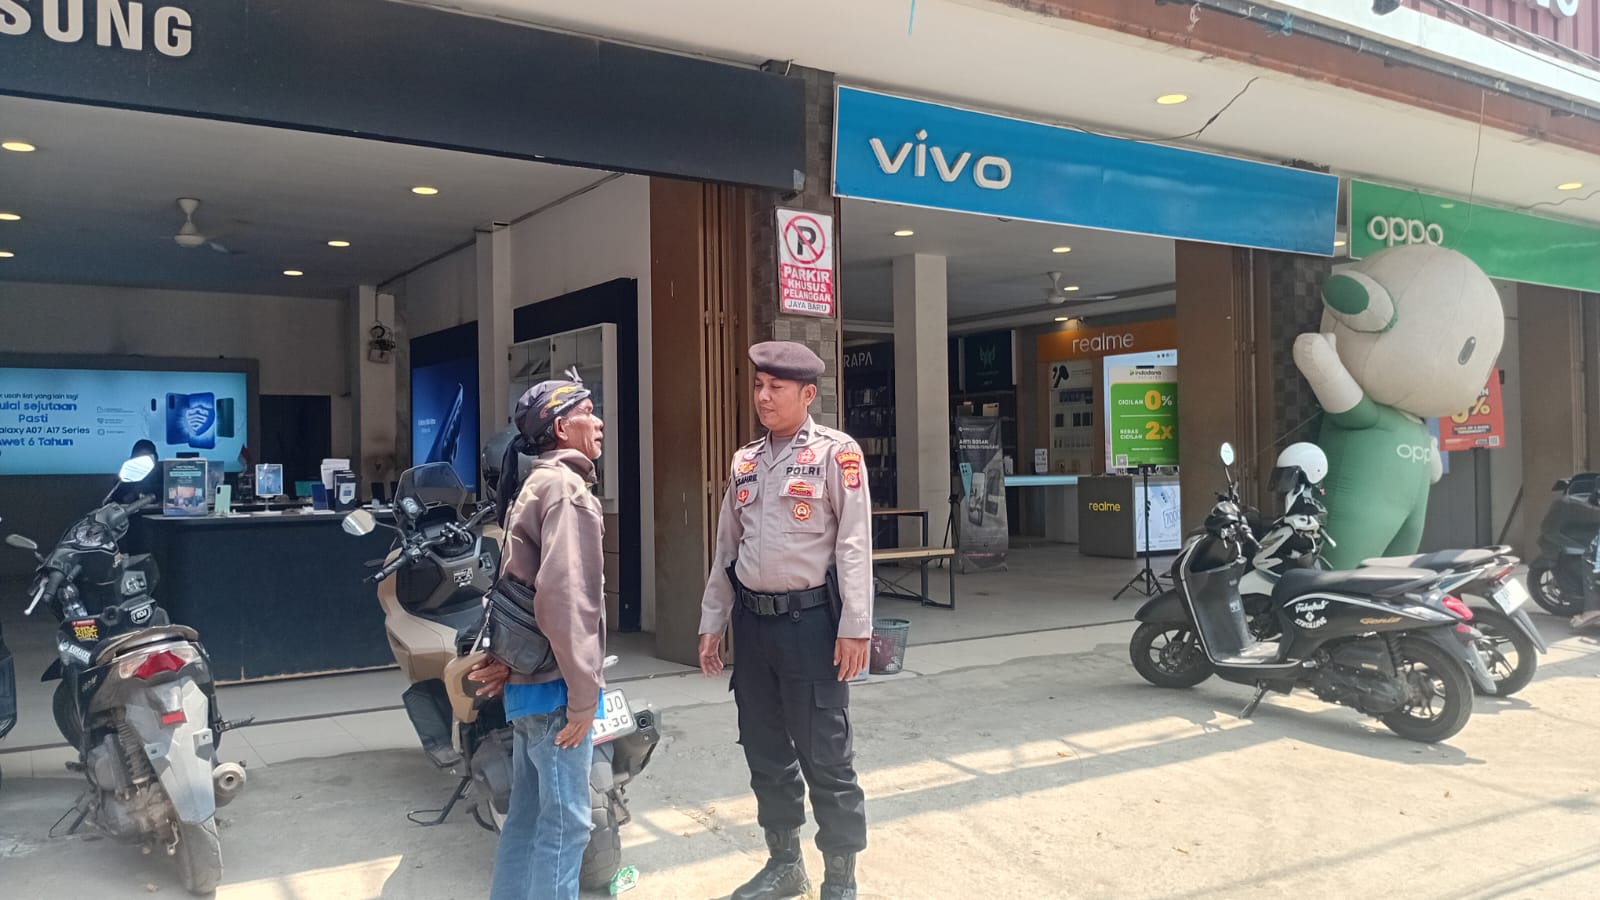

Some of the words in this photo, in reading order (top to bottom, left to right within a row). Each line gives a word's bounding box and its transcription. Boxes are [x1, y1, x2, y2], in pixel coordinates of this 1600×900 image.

[869, 129, 1012, 190] vivo
[1367, 215, 1443, 247] oppo
[783, 266, 831, 284] PARKIR
[788, 280, 827, 292] KHUSUS
[784, 288, 832, 303] PELANGGAN
[788, 300, 808, 310] JAYA
[808, 302, 828, 312] BARU
[1072, 332, 1134, 353] realme
[1144, 390, 1172, 410] 0%
[23, 402, 77, 412] sejutaan
[18, 413, 49, 424] Pasti
[62, 426, 90, 435] Series
[1145, 421, 1173, 441] 2x
[28, 437, 35, 446] 6
[38, 437, 74, 446] Tahun
[786, 466, 820, 476] POLRI
[1088, 501, 1121, 512] realme
